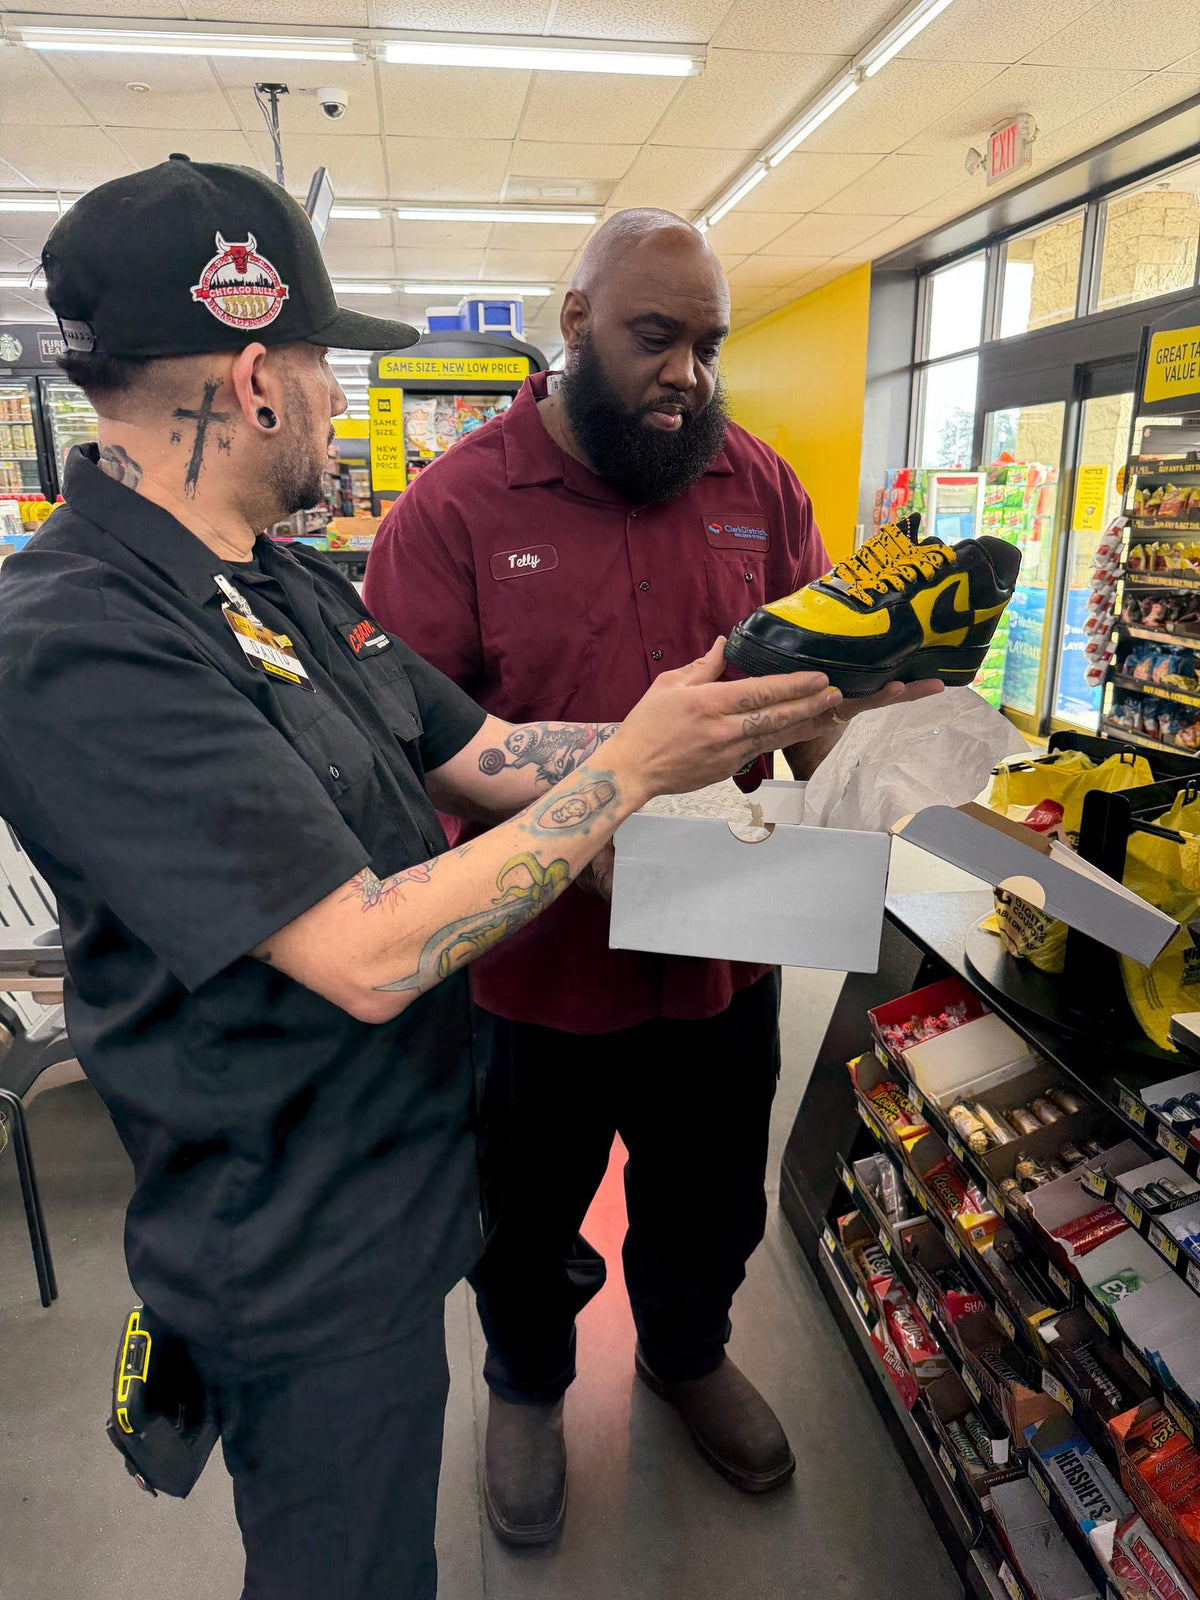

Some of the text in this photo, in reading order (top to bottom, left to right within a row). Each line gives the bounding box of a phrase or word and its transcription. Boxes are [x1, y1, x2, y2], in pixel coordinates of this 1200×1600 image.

[991, 123, 1018, 176] EXIT
[209, 286, 278, 298] CHICAGO BULLS
[1155, 344, 1188, 365] GREAT
[386, 362, 522, 374] SAME SIZE. NEW LOW PRICE.
[1164, 362, 1197, 382] VALUE
[374, 419, 398, 427] SAME
[376, 462, 400, 470] PRICE.
[508, 553, 541, 569] Telly
[883, 1350, 905, 1378] Turtles
[1053, 1448, 1112, 1521] HERSHEY'S
